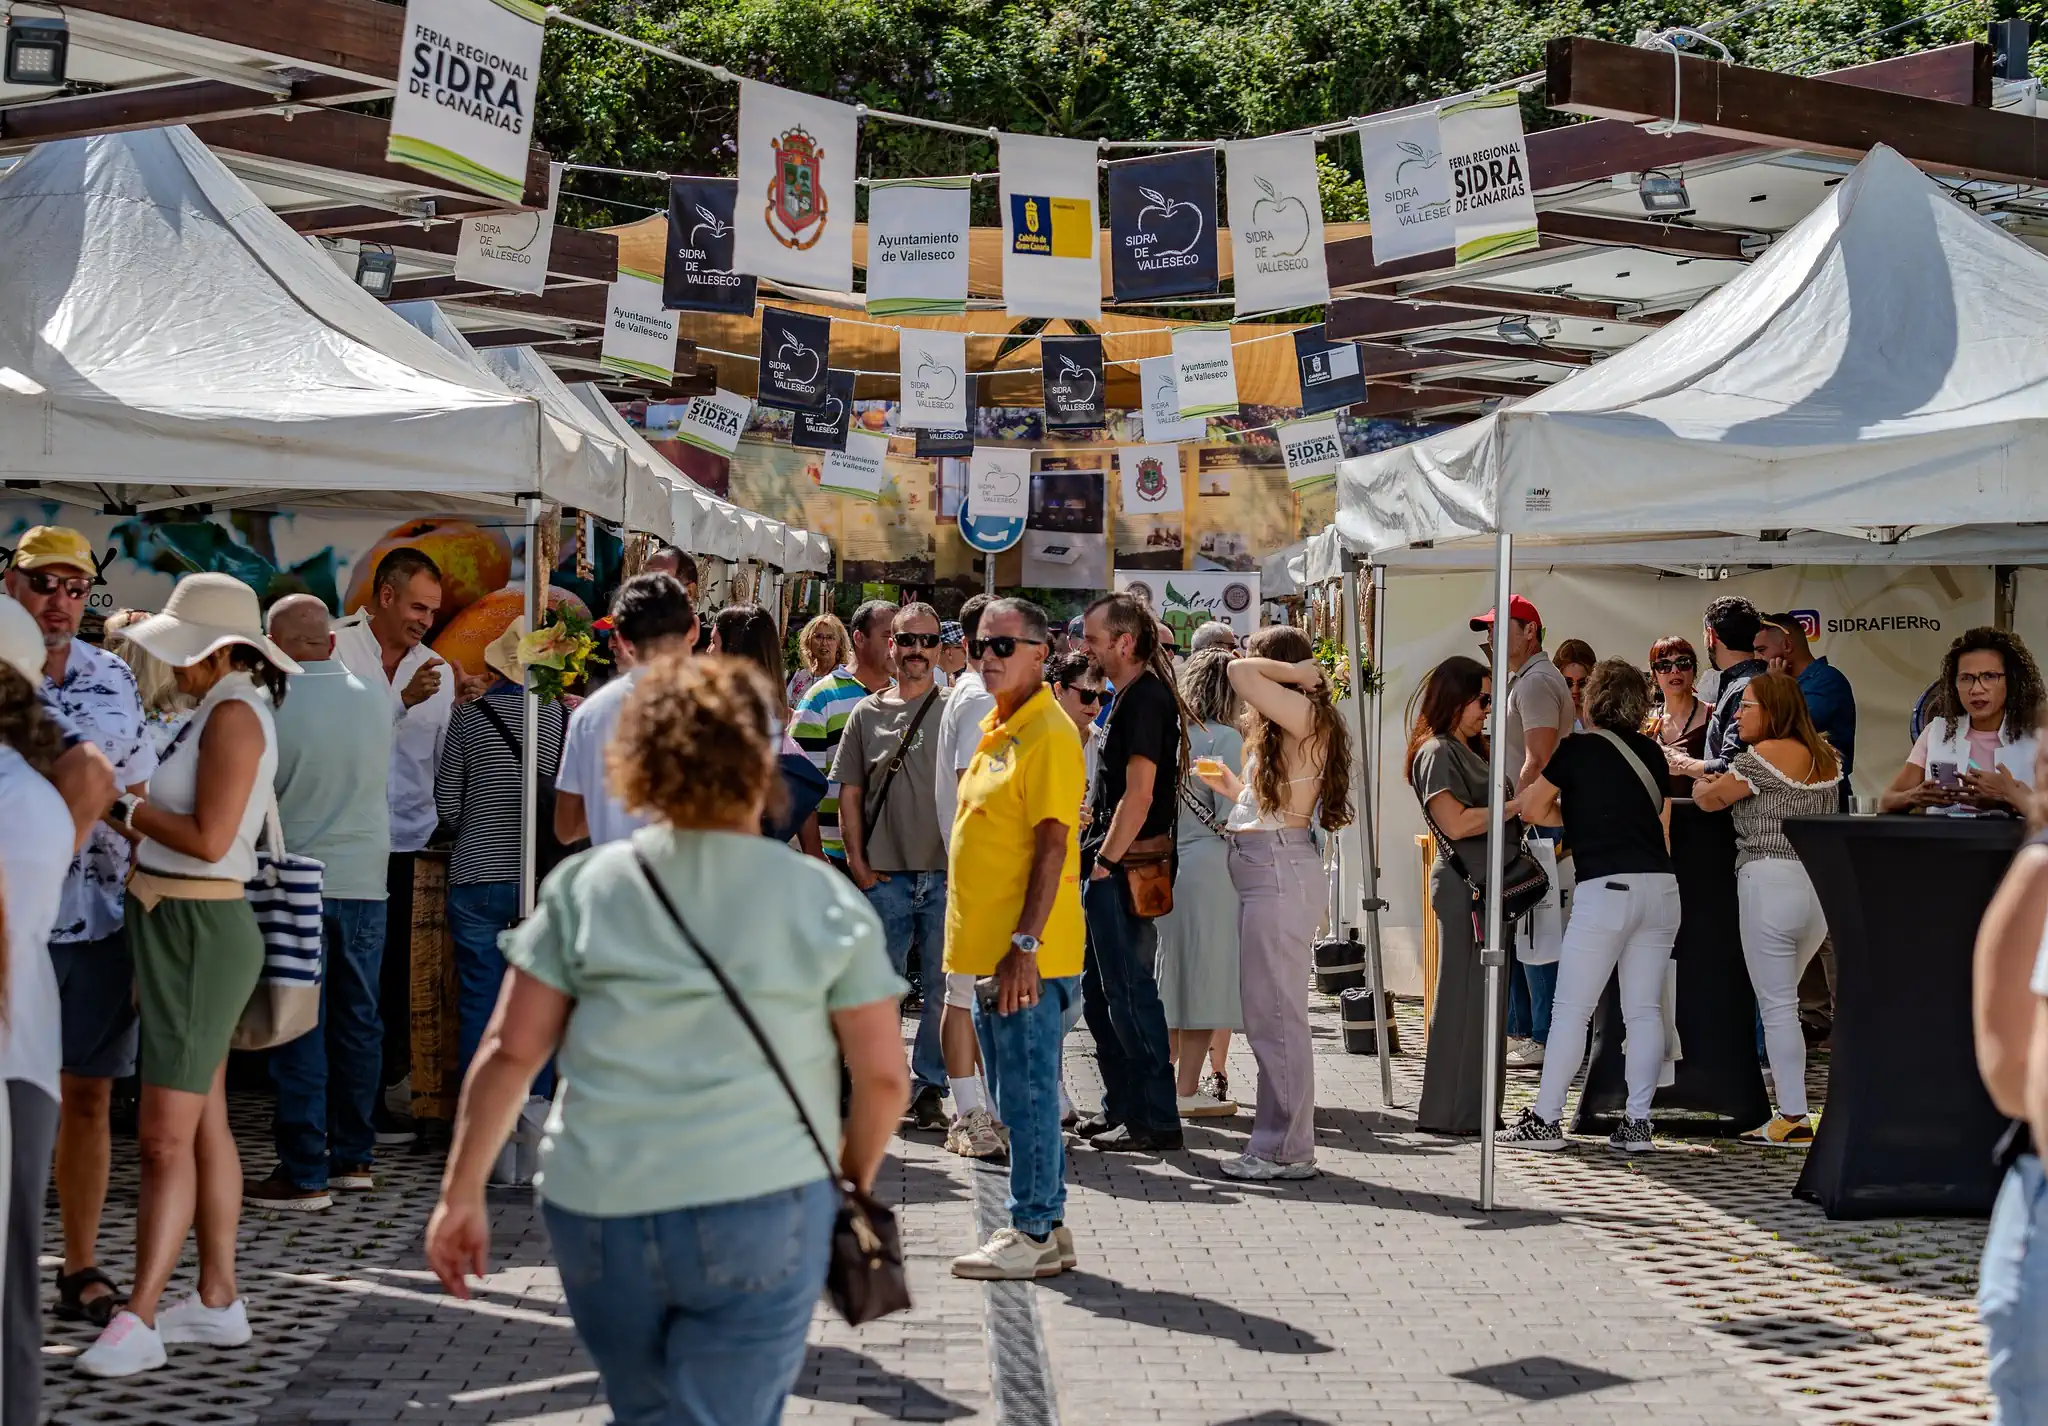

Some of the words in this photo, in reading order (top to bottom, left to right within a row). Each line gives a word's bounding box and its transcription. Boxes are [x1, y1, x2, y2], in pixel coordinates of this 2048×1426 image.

[416, 24, 452, 51] FERIA
[456, 41, 529, 81] REGIONAL
[411, 42, 524, 117] SIDRA
[409, 77, 431, 99] DE
[435, 88, 523, 135] CANARIAS
[1449, 154, 1472, 170] FERIA
[1472, 142, 1521, 163] REGIONAL
[1454, 155, 1523, 198] SIDRA
[1384, 186, 1419, 203] SIDRA
[1455, 198, 1468, 213] DE
[1470, 183, 1525, 209] CANARIAS
[1395, 202, 1411, 214] DE
[1398, 205, 1451, 227] VALLESEC
[474, 222, 502, 235] SIDRA
[479, 235, 493, 246] DE
[877, 232, 959, 249] Ayuntamiento
[1125, 232, 1158, 246] SIDRA
[1245, 230, 1275, 244] SIDRA
[480, 247, 531, 264] VALLESECO
[678, 248, 707, 259] SIDRA
[881, 250, 897, 262] de
[899, 249, 956, 262] Valleseco
[1134, 247, 1149, 258] DE
[1254, 246, 1267, 258] DE
[685, 261, 699, 272] DE
[1137, 254, 1199, 271] VALLESECO
[1256, 257, 1309, 273] VALLESECO
[686, 274, 741, 287] VALLESECO
[613, 306, 672, 330] Ayuntamiento
[614, 320, 626, 329] de
[628, 322, 669, 341] Valleseco
[768, 360, 791, 371] SIDRA
[1181, 359, 1229, 374] Ayuntamiento
[773, 370, 785, 380] DE
[1184, 374, 1194, 382] de
[1193, 370, 1228, 381] Valleseco
[774, 380, 816, 394] VALLESECO
[910, 381, 930, 389] SIDRA
[1052, 386, 1072, 394] SIDRA
[915, 390, 925, 399] DE
[1057, 395, 1067, 403] DE
[712, 402, 743, 419] REGIONAL
[917, 400, 955, 410] VALLESECO
[1059, 403, 1095, 411] VALLESECO
[1151, 401, 1169, 410] SIDRA
[690, 402, 738, 430] SIDRA
[1157, 416, 1181, 425] VALLES
[687, 413, 697, 421] DE
[698, 417, 738, 437] CANARIAS
[806, 425, 839, 434] VALLESECO
[1285, 442, 1303, 450] FERIA
[1303, 434, 1336, 445] REGIONAL
[1287, 440, 1338, 462] SIDRA
[830, 451, 879, 466] Ayuntamiento
[1289, 460, 1300, 468] DE
[1300, 451, 1340, 466] CANARIAS
[842, 461, 876, 473] Valleseco
[1827, 615, 1941, 633] SIDRAFIERRO
